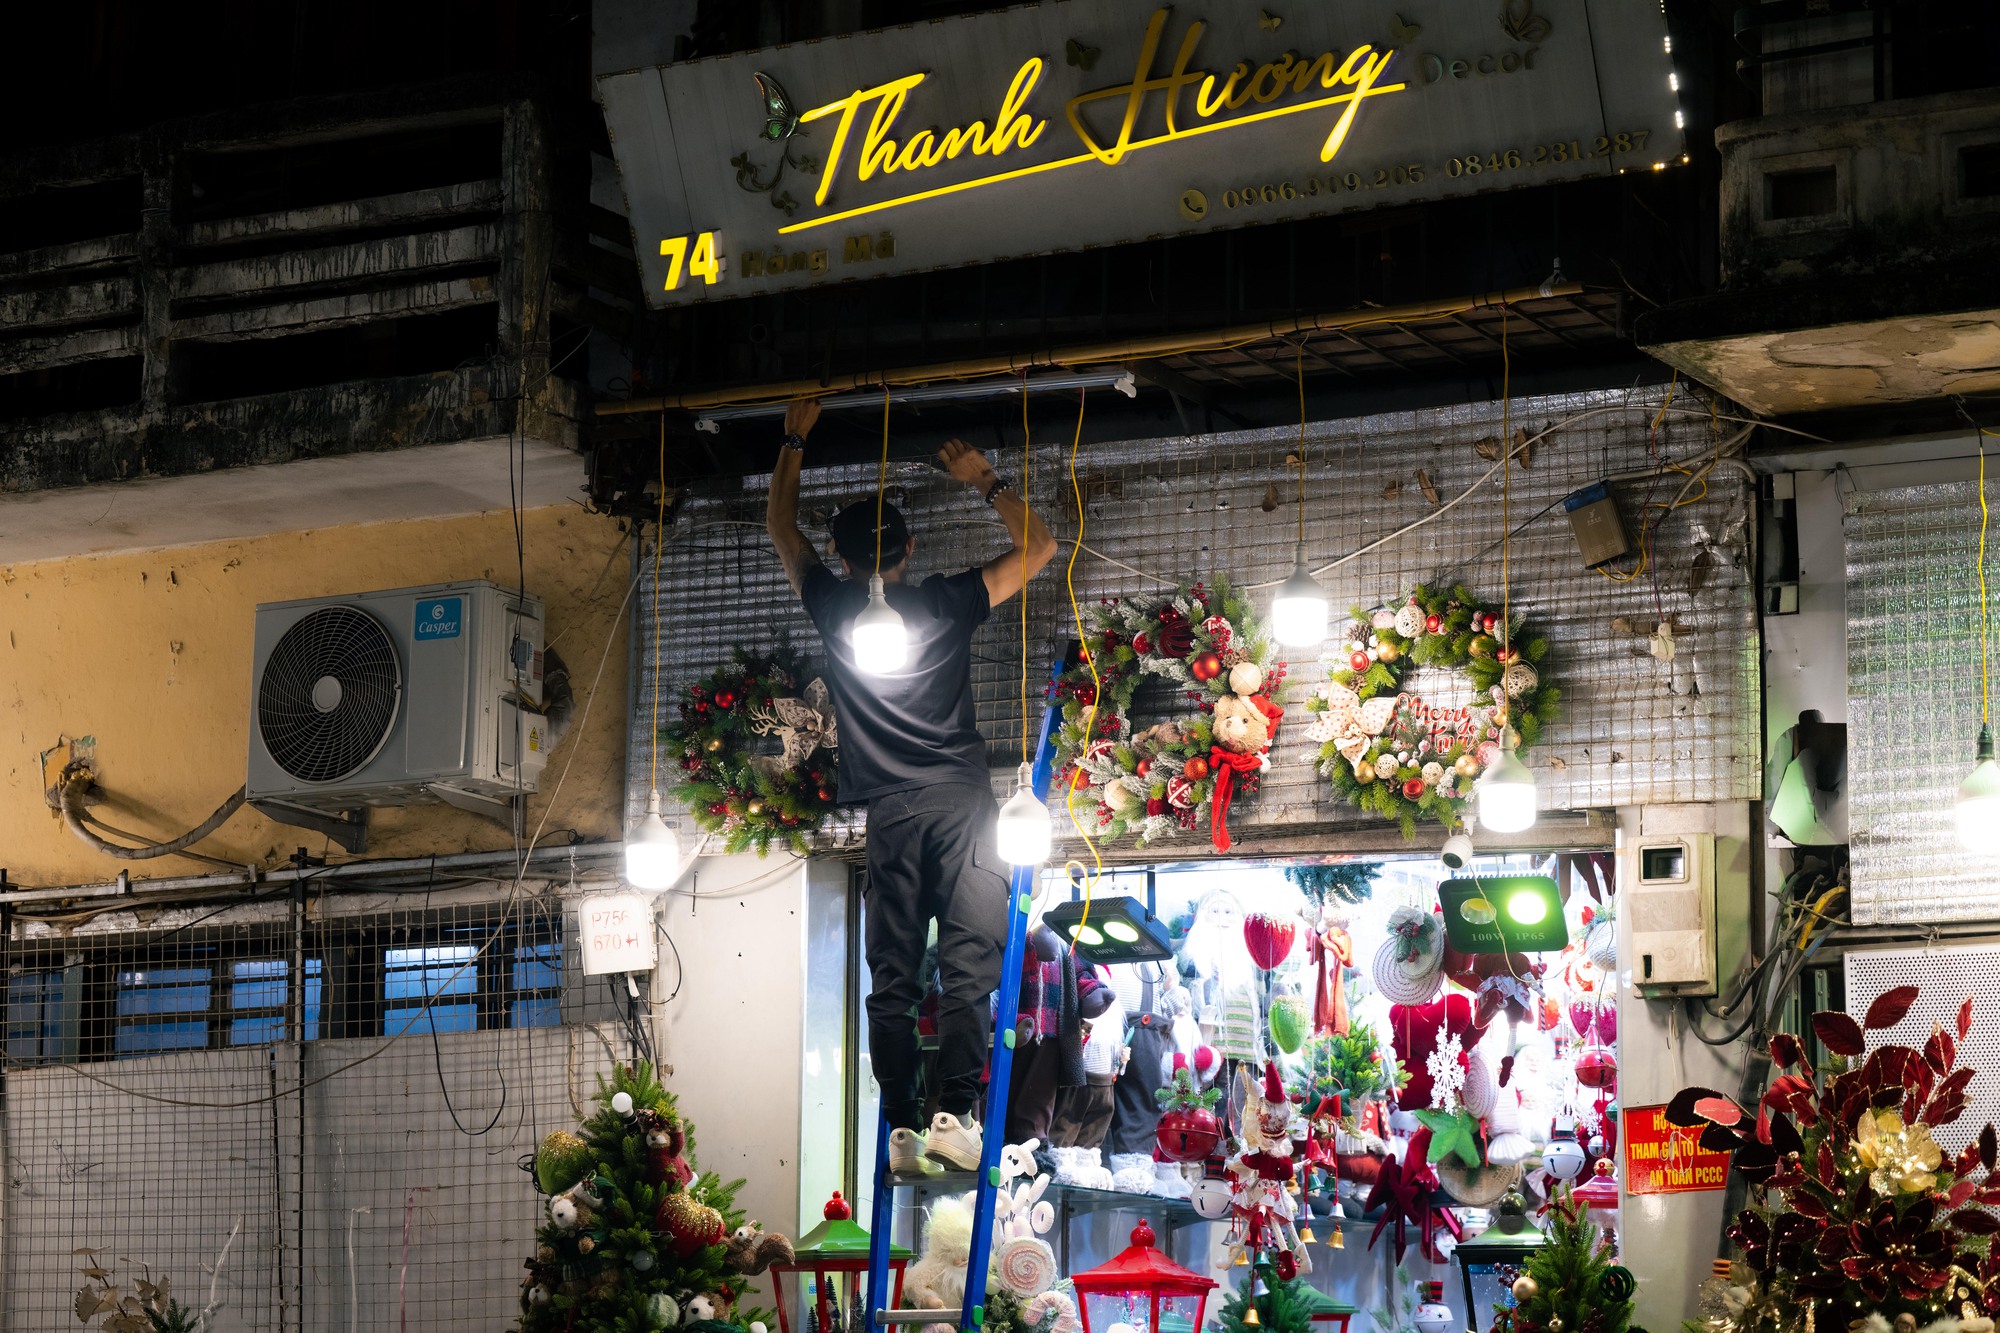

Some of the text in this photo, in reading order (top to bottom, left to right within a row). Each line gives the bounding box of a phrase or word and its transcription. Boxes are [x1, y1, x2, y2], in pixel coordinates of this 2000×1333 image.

[799, 3, 1540, 206] Thanh Hương Decor
[1222, 130, 1651, 209] 0966.909.205 0846.231.287
[659, 232, 719, 291] 74
[419, 621, 457, 635] Casper
[1397, 692, 1472, 736] Merry
[1516, 932, 1545, 941] IP65
[1630, 1142, 1659, 1159] THAM
[1661, 1141, 1679, 1158] GA
[1649, 1170, 1664, 1187] AN
[1695, 1166, 1723, 1184] PCCC
